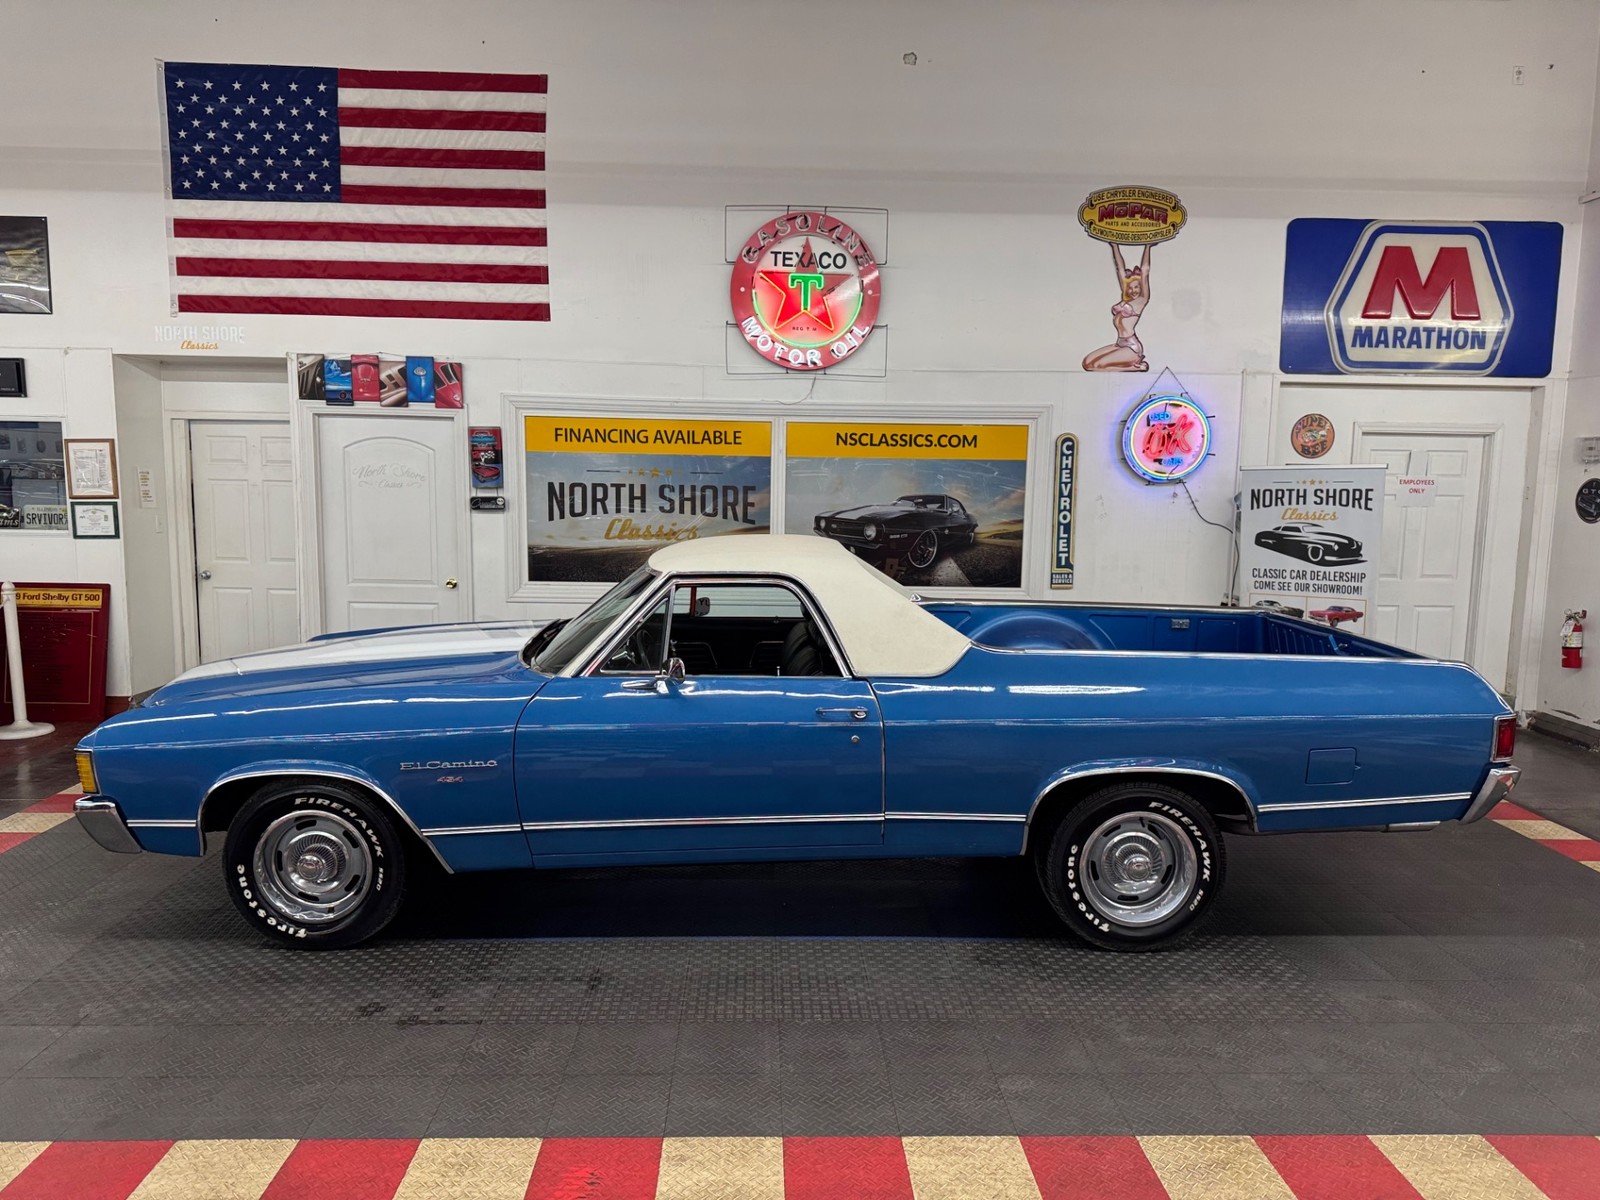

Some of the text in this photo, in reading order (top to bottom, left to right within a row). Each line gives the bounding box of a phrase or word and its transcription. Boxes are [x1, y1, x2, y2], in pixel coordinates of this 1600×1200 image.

[1094, 190, 1174, 204] USE CHRYSLER ENGINEERED
[1098, 202, 1168, 224] MOPAR
[742, 214, 875, 271] GASOLINE
[770, 251, 847, 269] TEXACO
[788, 273, 824, 312] T
[1361, 246, 1482, 322] M
[154, 325, 245, 344] NORTH SHORE
[180, 340, 218, 350] Classics
[742, 316, 870, 368] MOTOR OIL
[1351, 325, 1487, 350] MARATHON
[554, 427, 742, 445] FINANCING AVAILABLE
[835, 432, 978, 448] NSCLASSICS.COM
[1144, 414, 1194, 460] OK
[1300, 440, 1328, 456] BEE
[547, 482, 757, 525] NORTH SHORE
[1058, 441, 1073, 566] CHEVROLET
[1250, 488, 1374, 512] NORTH SHORE
[1281, 507, 1339, 521] Classics
[604, 518, 699, 541] Classics
[1252, 568, 1366, 583] CLASSIC CAR DEALERSHIP
[22, 592, 40, 600] Ford
[42, 592, 70, 602] Shelby
[1254, 581, 1363, 595] COME SEE OUR SHOWROOM!
[294, 797, 384, 859] FIREHAWK
[1148, 802, 1211, 882] FIREHAWK
